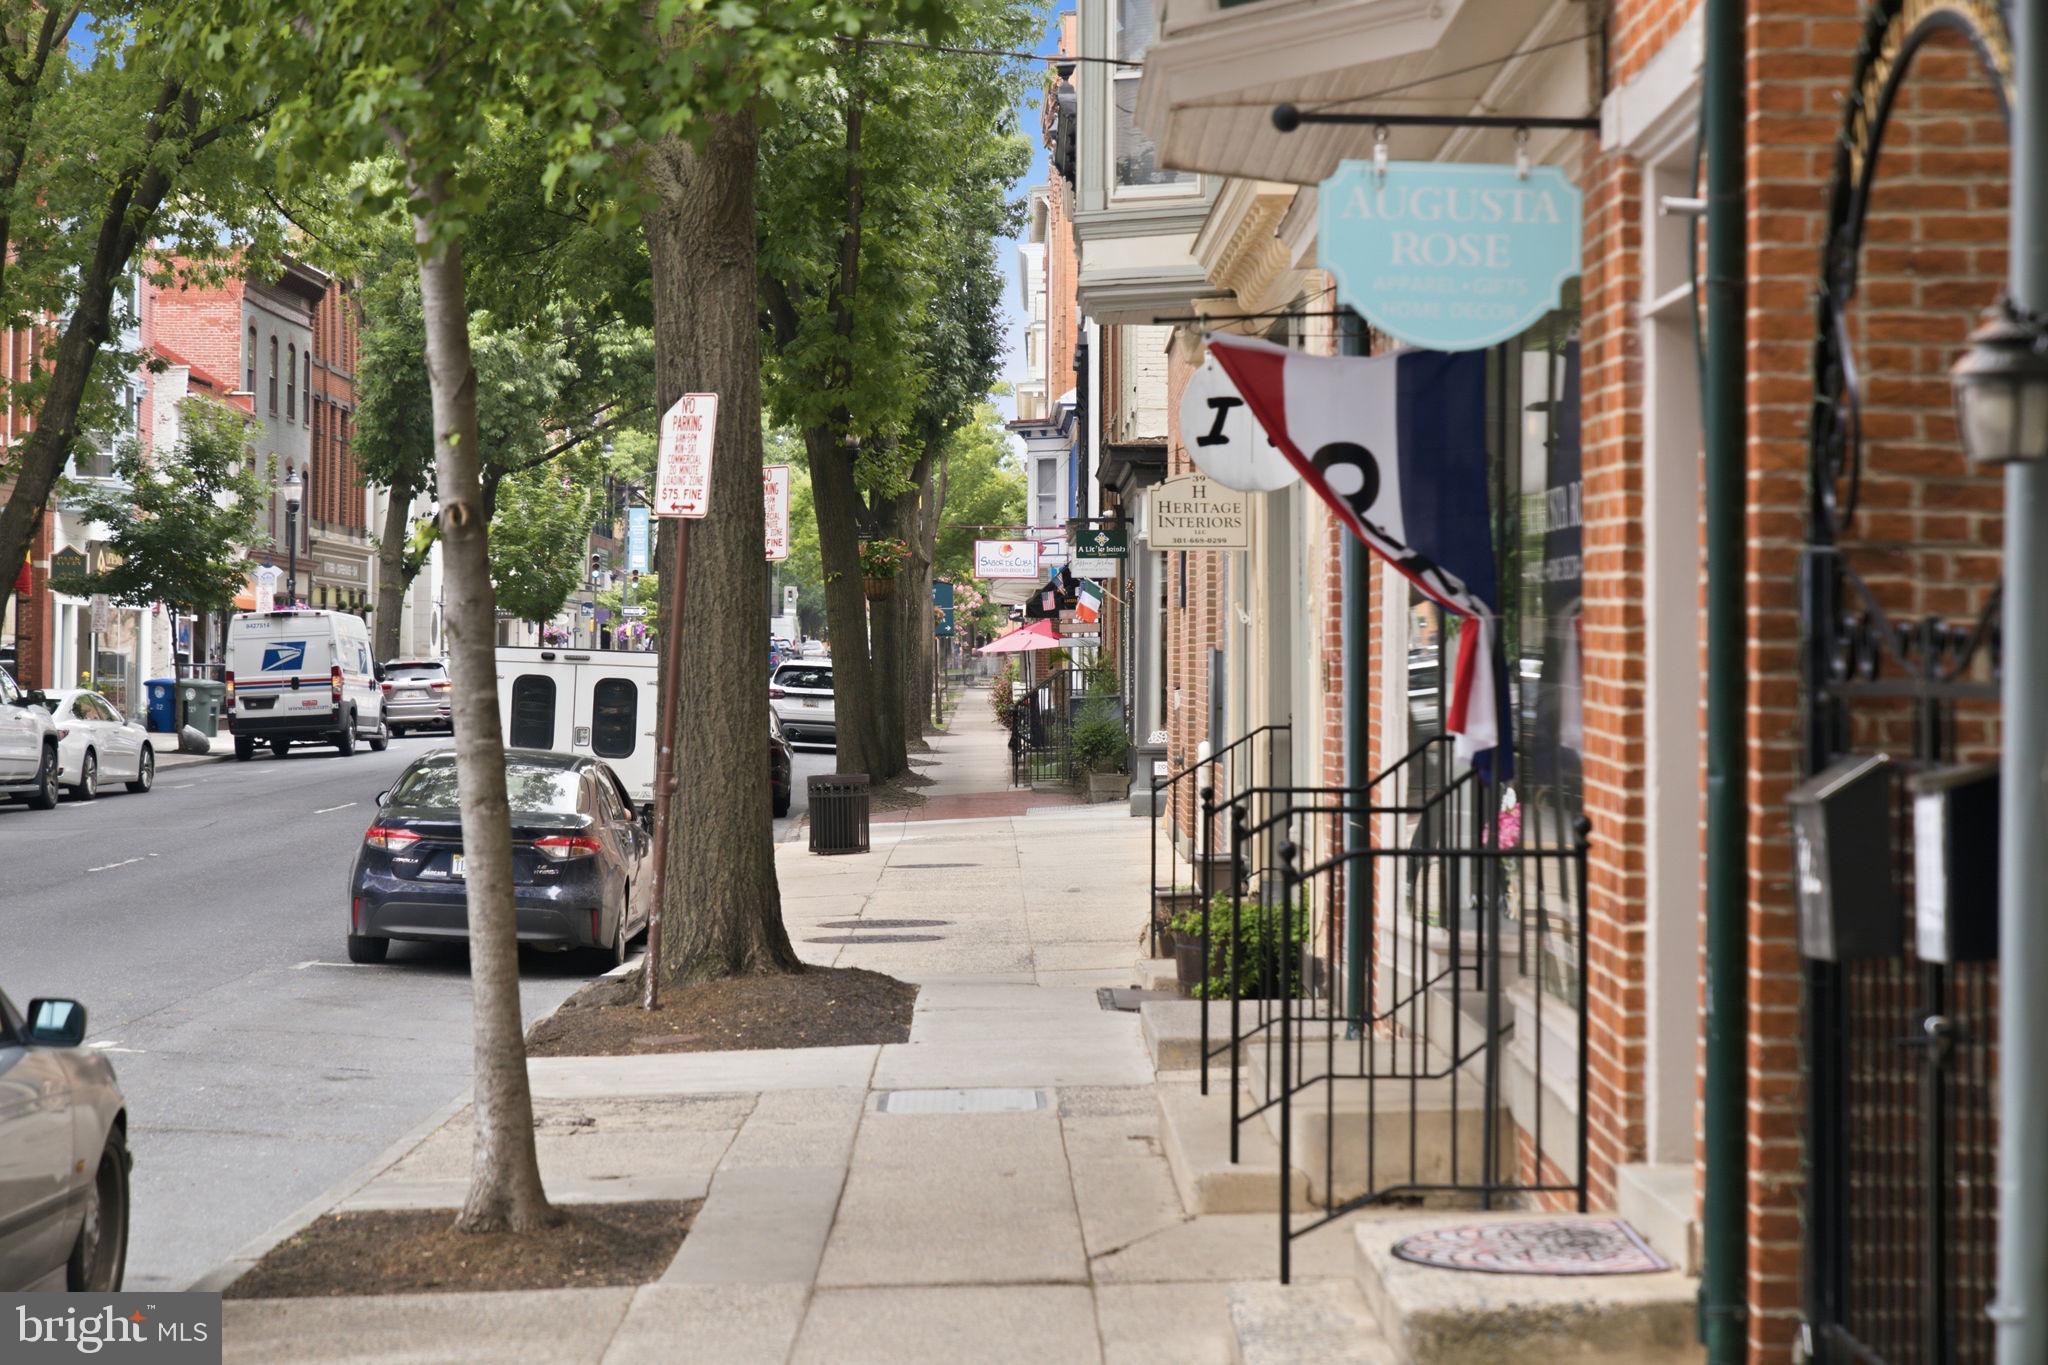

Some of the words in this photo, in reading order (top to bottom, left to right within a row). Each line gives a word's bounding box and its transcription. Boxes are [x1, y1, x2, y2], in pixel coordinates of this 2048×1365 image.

[1340, 185, 1561, 224] AUGUSTA
[1391, 230, 1512, 268] ROSE
[682, 397, 695, 413] NO
[672, 415, 703, 431] PARKING
[668, 454, 702, 465] COMMERCIAL
[680, 465, 700, 475] MINUTE
[663, 475, 686, 486] LOADING
[689, 475, 704, 486] ZONE
[683, 489, 703, 500] FINE
[1192, 485, 1207, 498] H
[1158, 501, 1241, 514] HERITAGE
[1158, 515, 1242, 528] INTERIORS
[766, 537, 783, 547] FINE
[980, 556, 1003, 567] SABOR
[1015, 557, 1033, 567] CUBA
